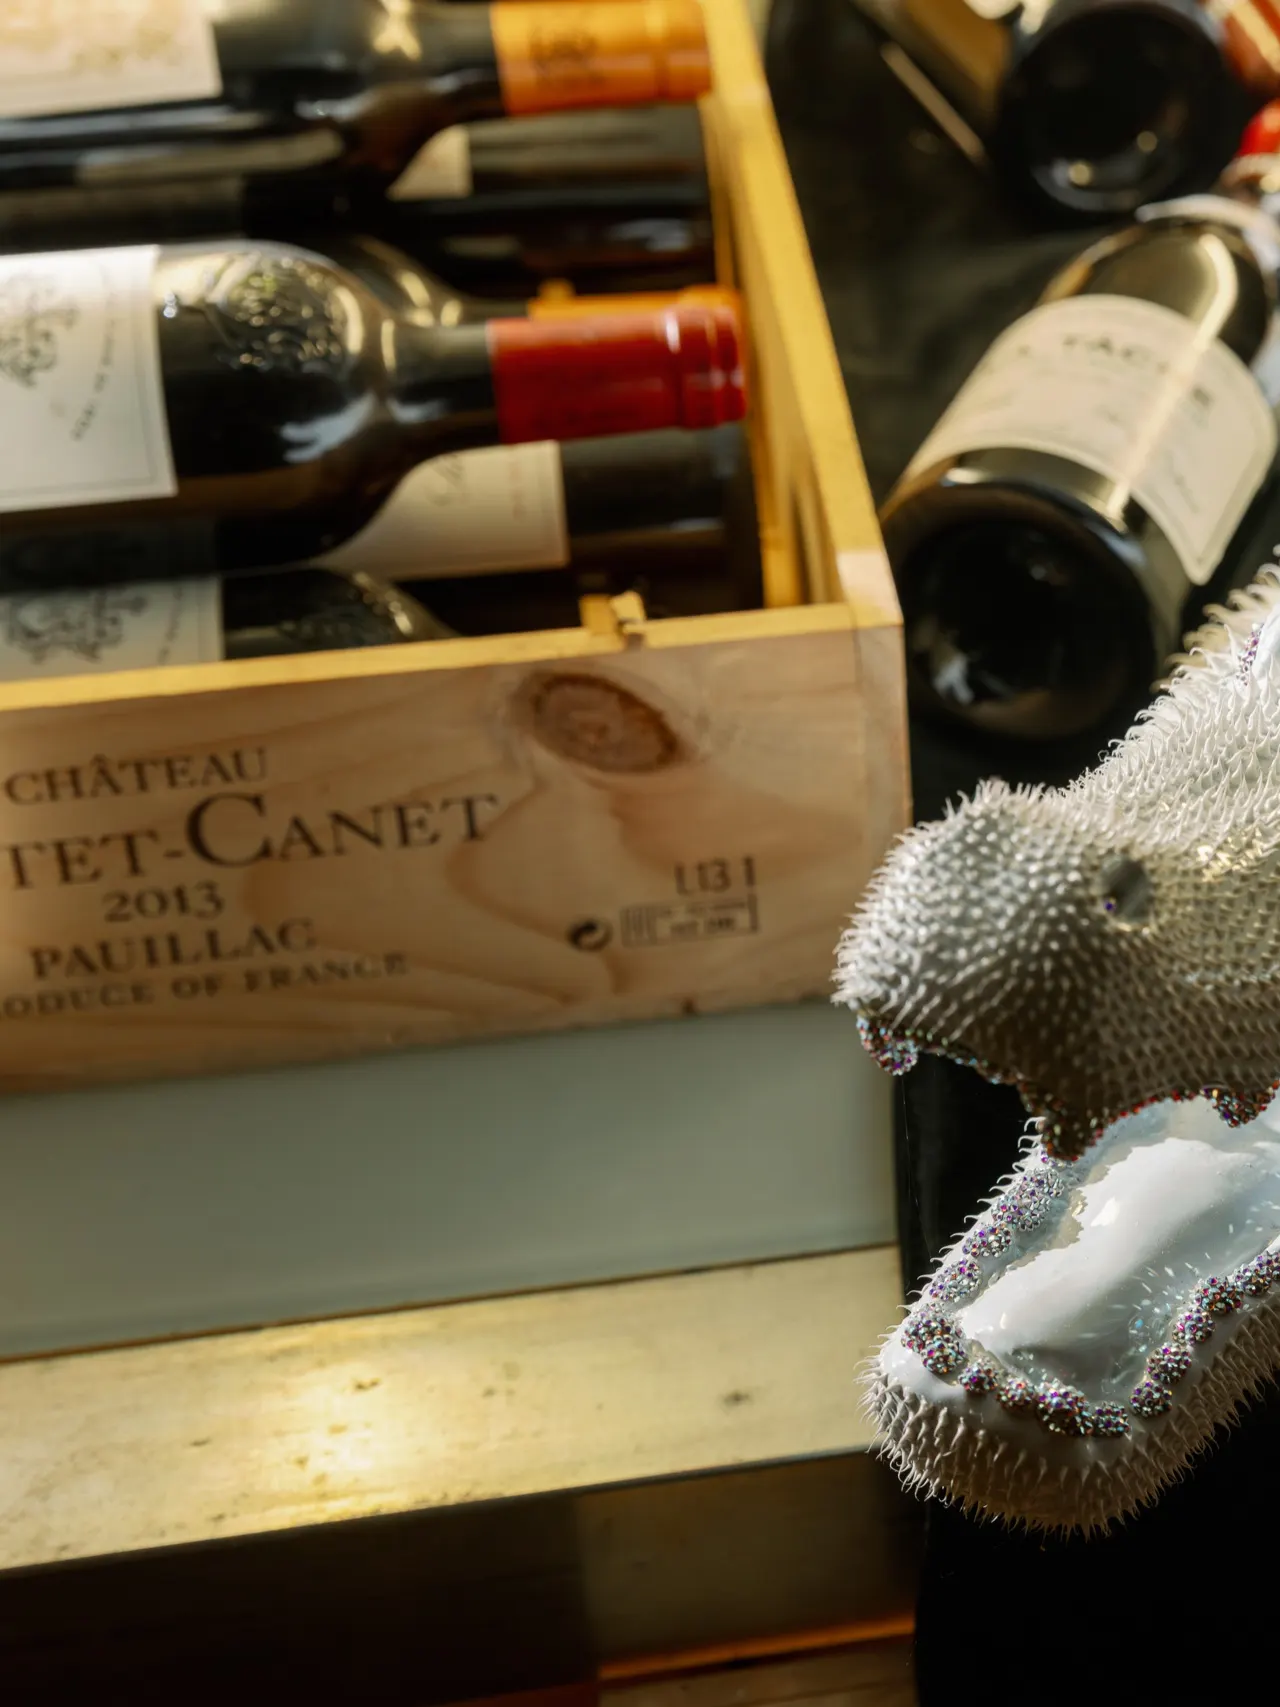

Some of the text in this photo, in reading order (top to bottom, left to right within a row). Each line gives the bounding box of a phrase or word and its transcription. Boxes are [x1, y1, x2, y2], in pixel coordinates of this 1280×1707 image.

[3, 747, 267, 806] CHÂTEAU
[102, 880, 225, 924] 2013
[29, 917, 318, 980] PAUILLAC
[171, 968, 225, 1000] OF
